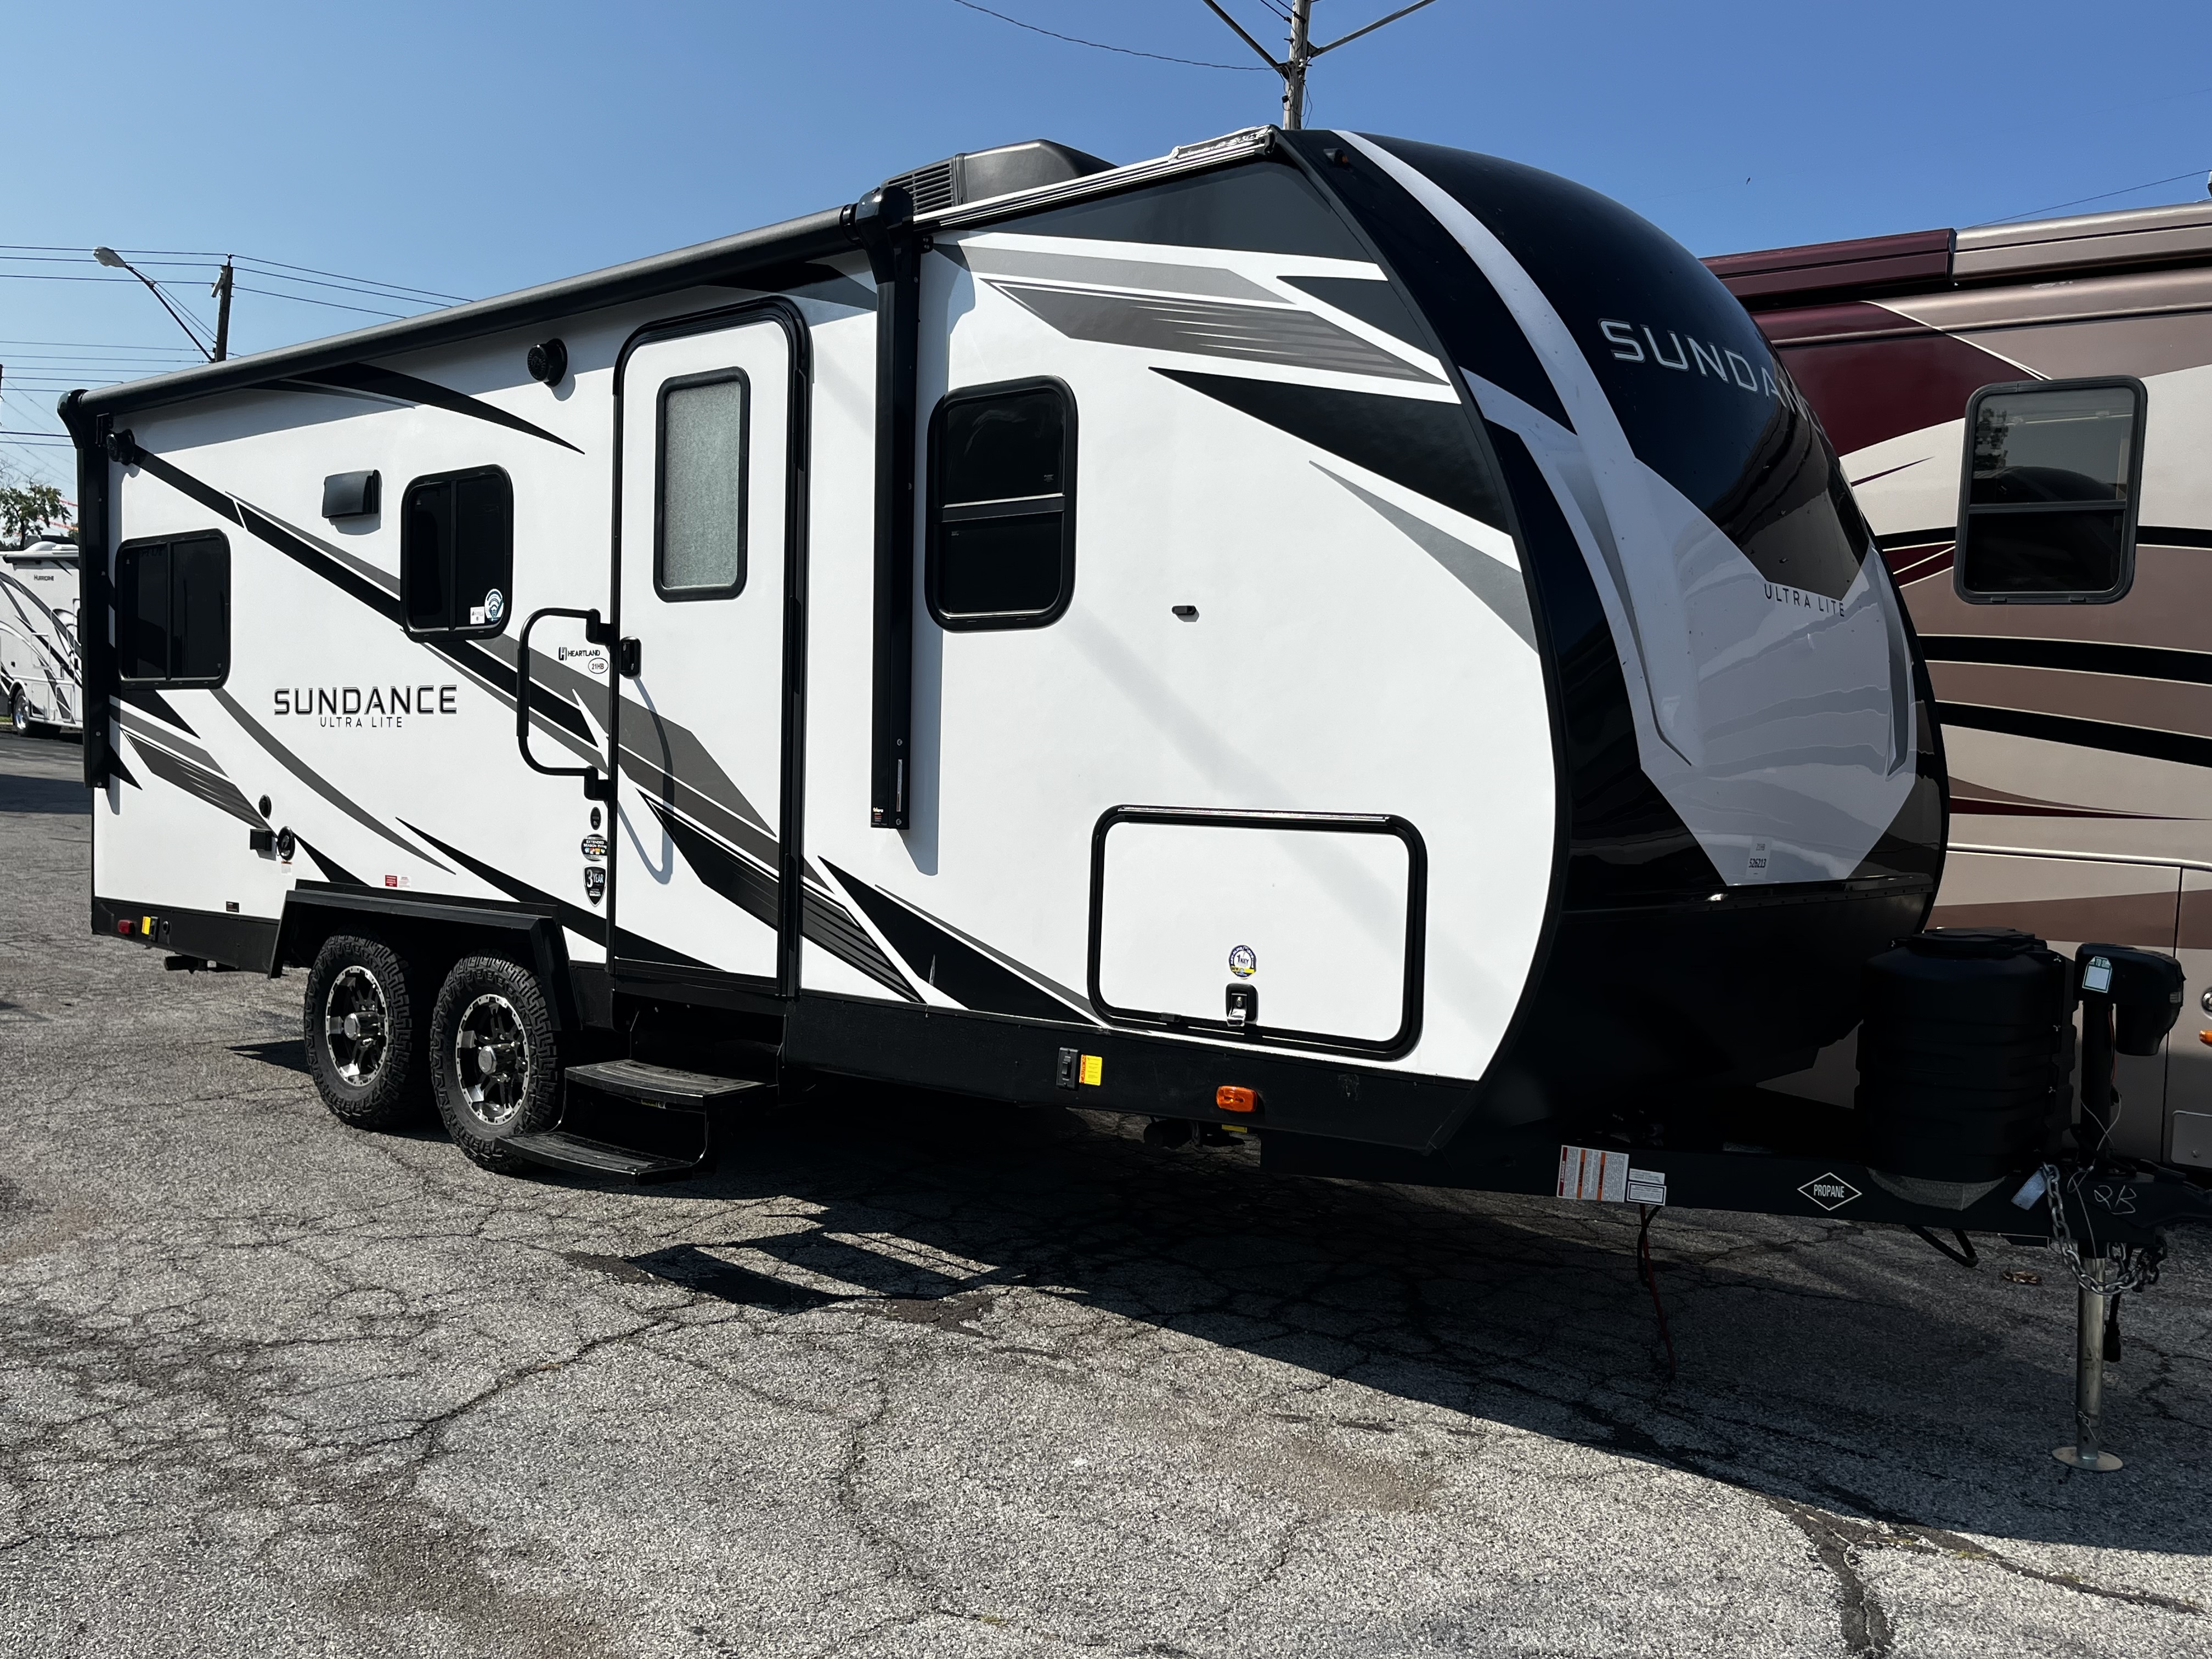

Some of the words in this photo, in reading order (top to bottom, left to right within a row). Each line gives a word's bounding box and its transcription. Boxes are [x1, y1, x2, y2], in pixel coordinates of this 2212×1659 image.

[1764, 583, 1811, 609] ULTRA
[1818, 596, 1844, 618] LITE
[274, 685, 457, 715] SUNDANCE
[320, 716, 362, 728] ULTRA
[371, 716, 402, 728] LITE
[586, 869, 593, 888] 3
[592, 873, 604, 883] YEAR
[1814, 1184, 1844, 1198] PROPANE
